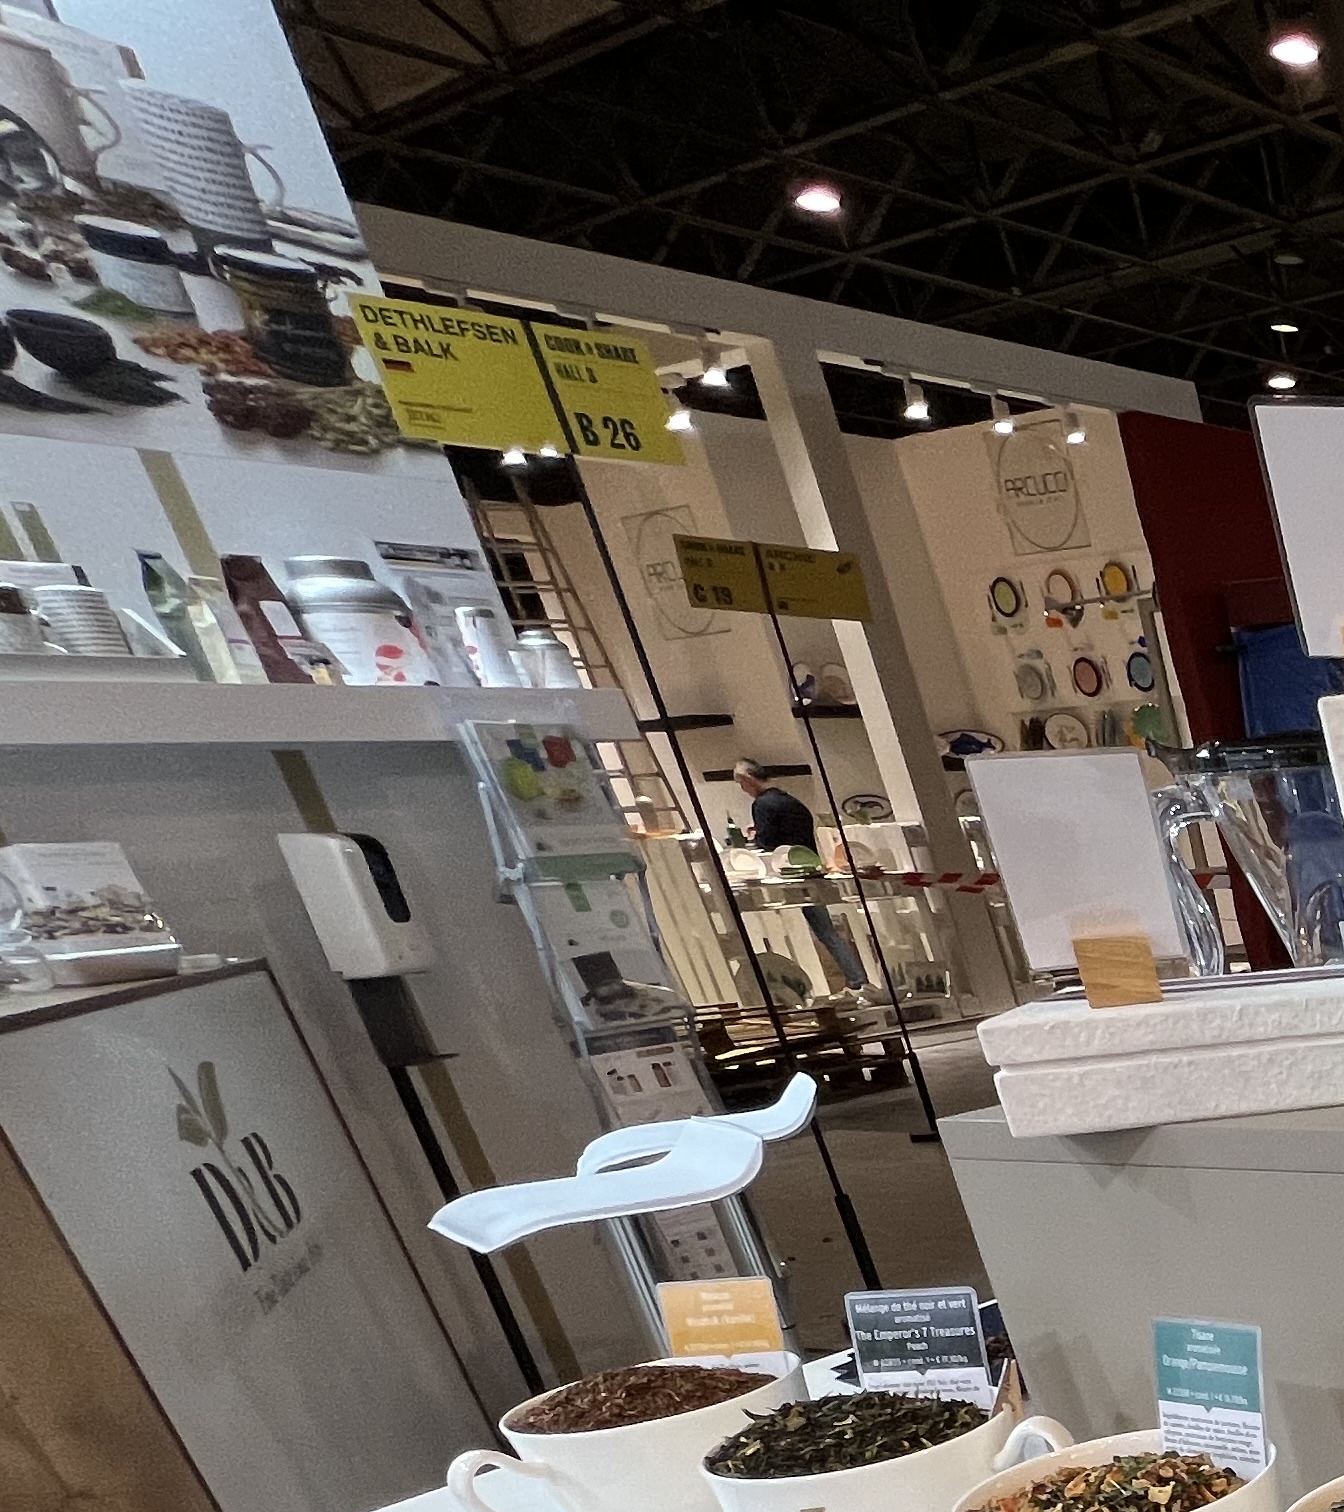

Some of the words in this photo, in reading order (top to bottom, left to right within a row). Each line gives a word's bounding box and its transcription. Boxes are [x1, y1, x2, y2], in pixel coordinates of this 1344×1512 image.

[359, 304, 519, 345] DETHLEFSEN
[393, 335, 458, 362] BALK
[574, 412, 599, 446] B
[603, 416, 641, 451] 26
